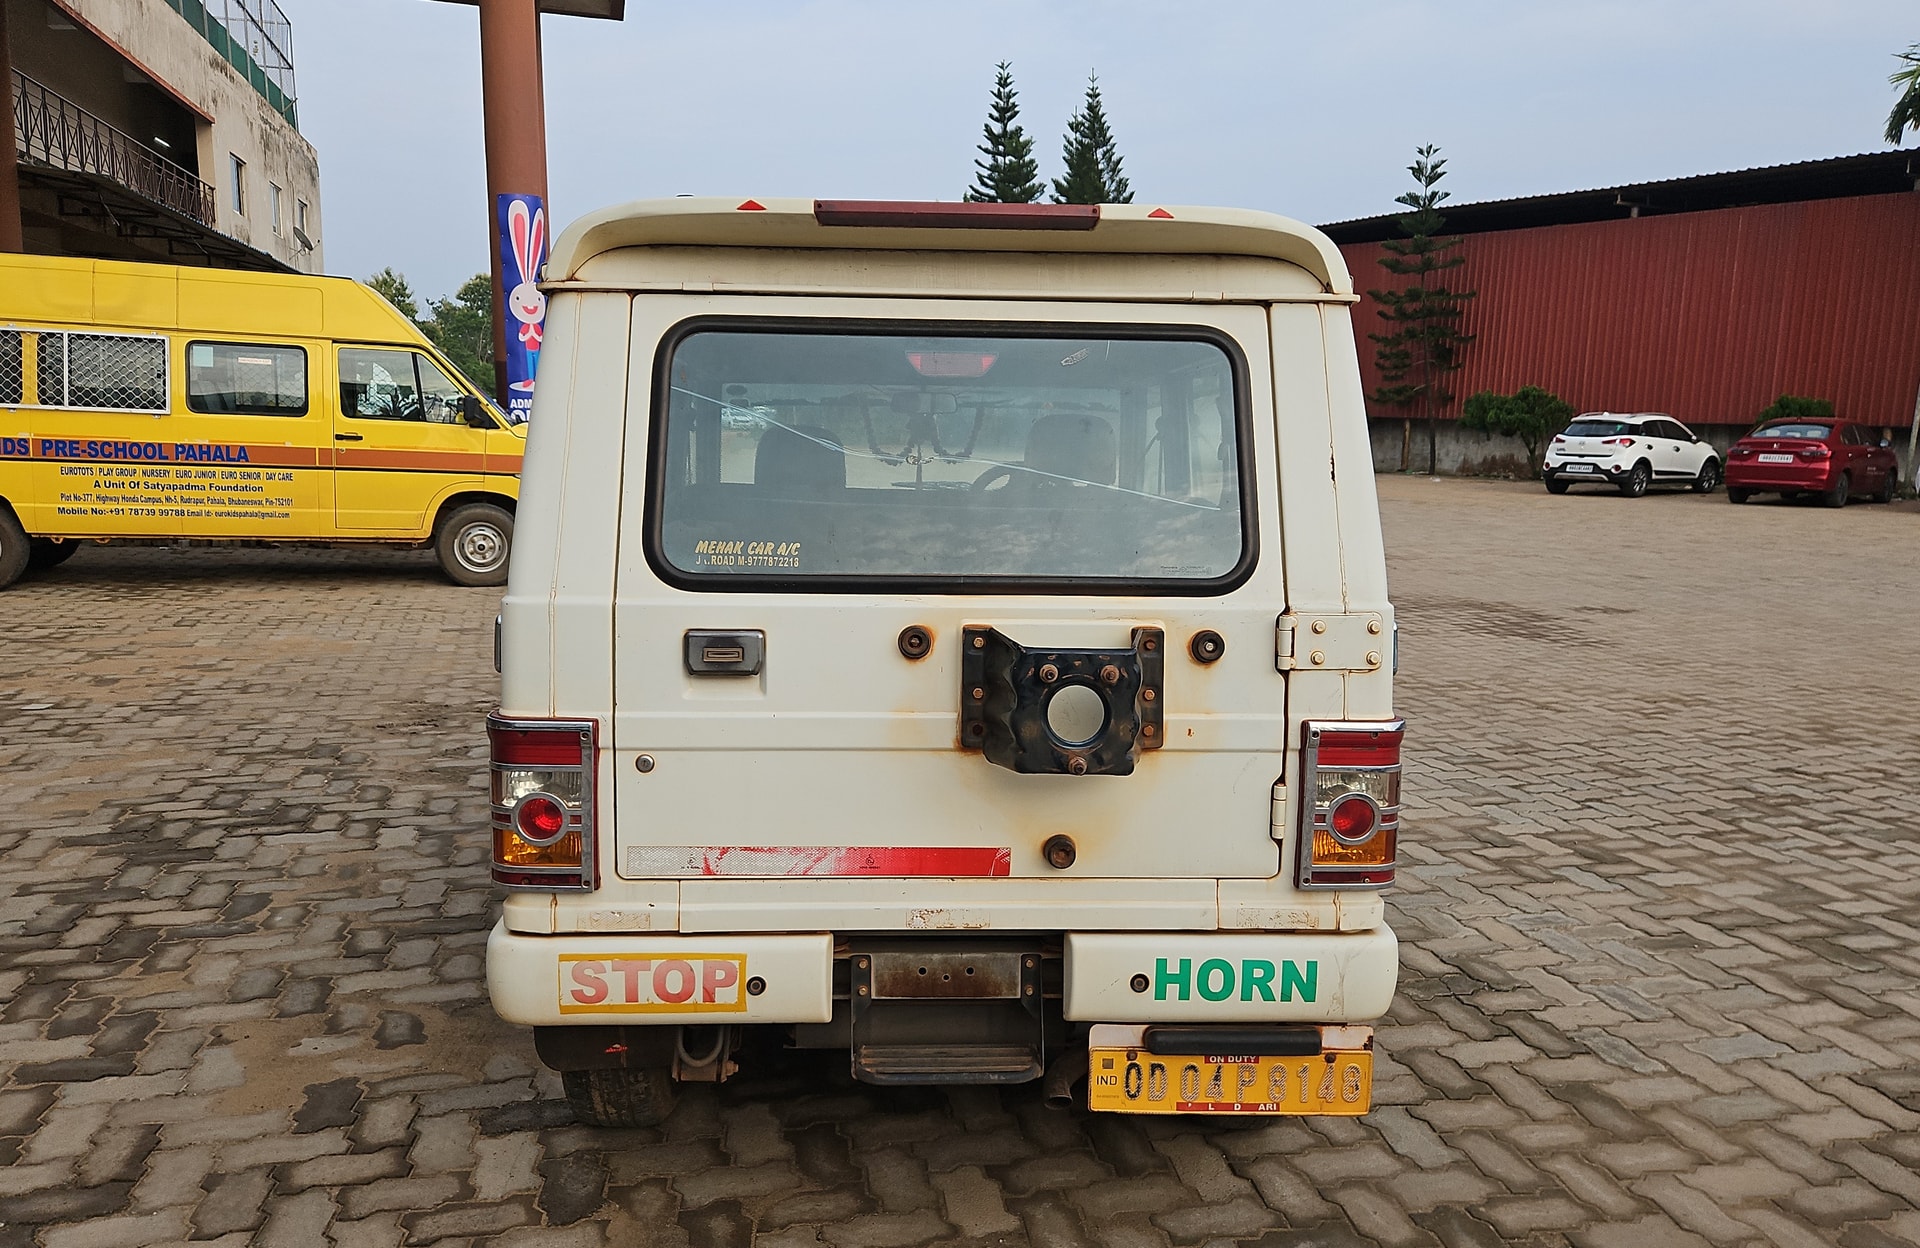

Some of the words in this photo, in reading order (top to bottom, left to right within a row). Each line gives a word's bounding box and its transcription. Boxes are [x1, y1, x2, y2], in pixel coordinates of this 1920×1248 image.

[41, 439, 169, 460] PRE-SCHOOL
[175, 444, 250, 462] PAHALA
[60, 467, 94, 476] EUROTOTS
[98, 467, 114, 477] PLAY
[115, 468, 137, 477] GROUP
[141, 469, 170, 479] NURSERY
[175, 470, 192, 479] EURO
[193, 470, 217, 480] JUNIOR
[221, 471, 238, 480] EURO
[239, 471, 262, 481] SENIOR
[265, 473, 277, 481] DAY
[278, 472, 294, 482] CARE
[93, 480, 101, 489] A
[104, 480, 126, 489] Unit
[128, 481, 141, 490] Of
[143, 481, 206, 492] Satyapadma
[208, 483, 264, 493] Foundation
[60, 493, 72, 502] Plot
[96, 494, 120, 504] Highway
[121, 494, 139, 503] Honda
[58, 507, 88, 515] Mobile
[128, 508, 156, 516] 78739
[158, 509, 185, 517] 99788
[187, 509, 203, 517] Email
[695, 540, 745, 555] MEHAK
[747, 541, 775, 556] CAR
[776, 542, 801, 557] A/C
[570, 959, 739, 1005] STOP
[1153, 957, 1319, 1003] HORN
[1209, 1055, 1226, 1063] ON
[1228, 1055, 1257, 1063] DUTY
[1096, 1075, 1118, 1086] IND
